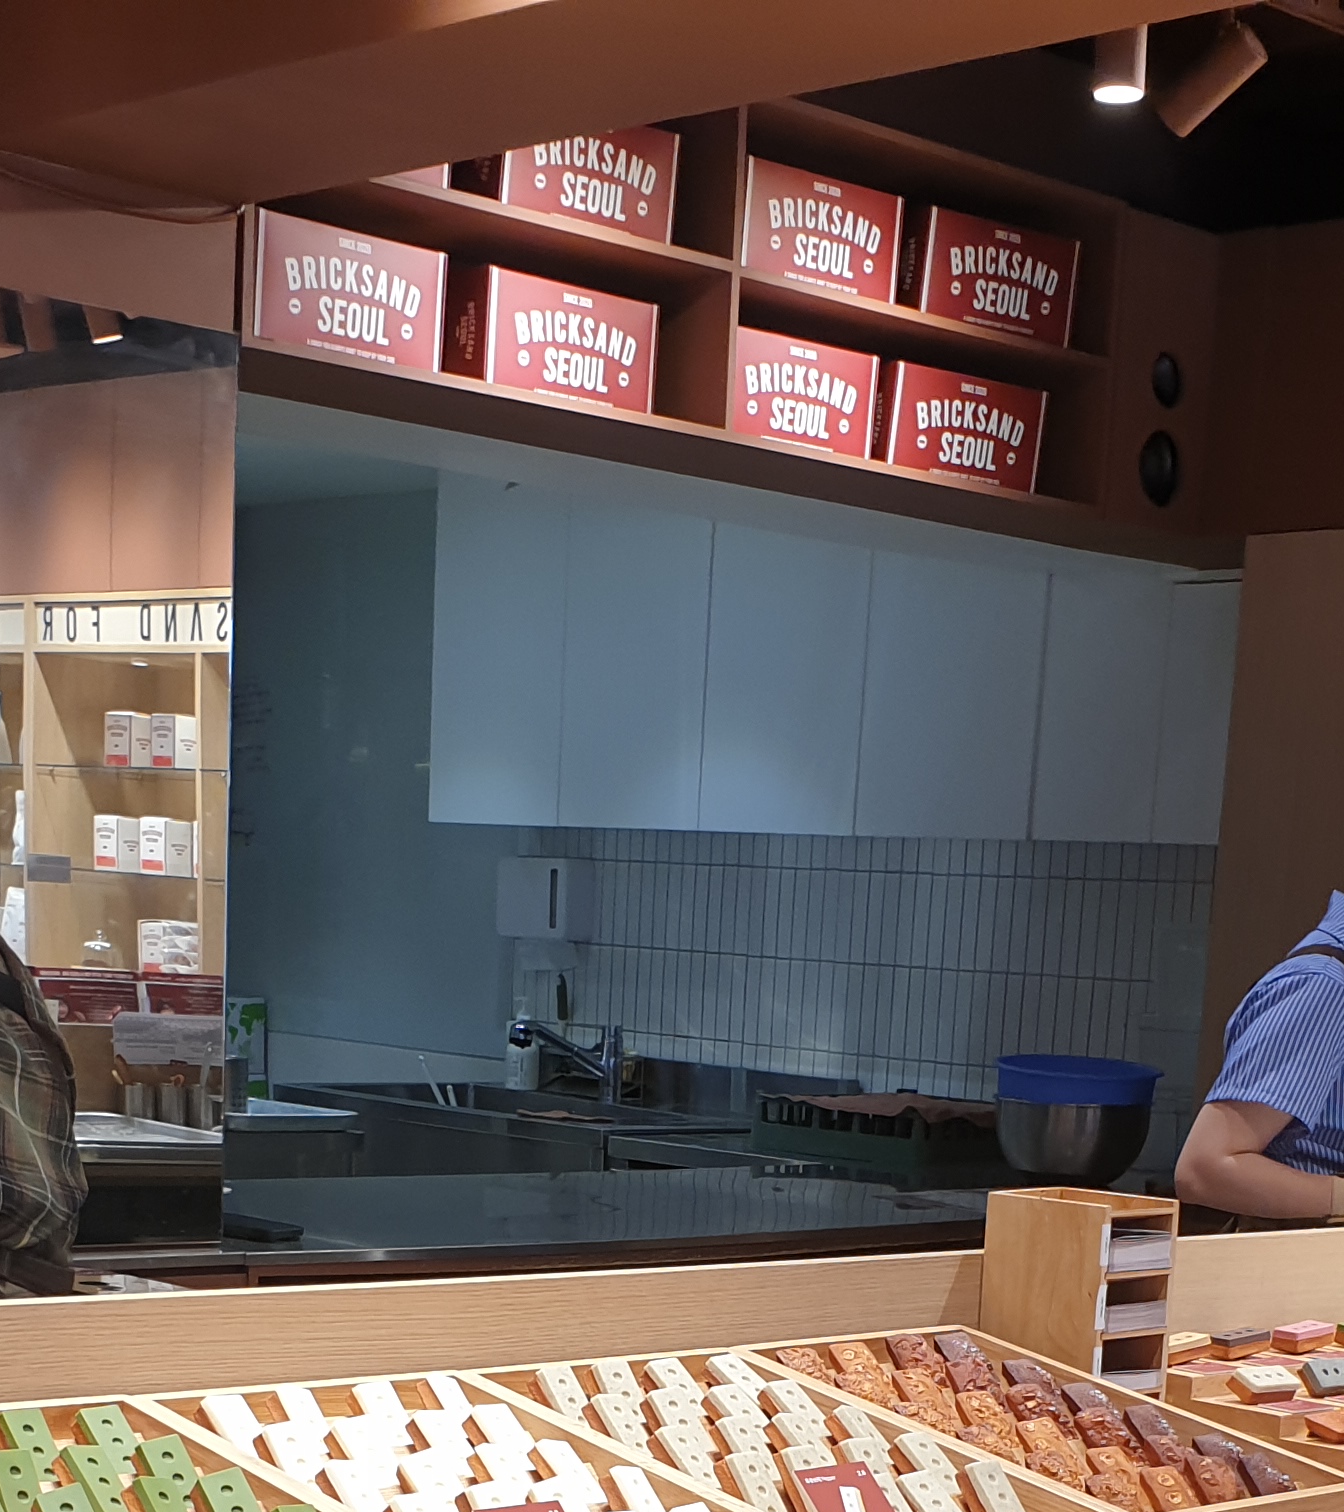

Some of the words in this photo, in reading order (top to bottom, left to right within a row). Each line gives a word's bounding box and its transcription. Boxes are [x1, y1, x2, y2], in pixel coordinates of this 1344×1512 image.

[533, 135, 657, 196] BRICKSAND
[560, 171, 626, 222] SEOUL
[768, 197, 881, 255] BRICKSAND
[793, 233, 854, 279] SEOUL
[950, 245, 1059, 296] BRICKSAND
[284, 255, 421, 319] BRICKSAND
[972, 278, 1031, 321] SEOUL
[317, 295, 390, 346] SEOUL
[514, 309, 637, 367] BRICKSAND
[542, 346, 608, 394] SEOUL
[745, 362, 858, 415] BRICKSAND
[769, 396, 830, 440] SEOUL
[916, 398, 1025, 447] BRICKSAND
[938, 431, 997, 472] SEOUL
